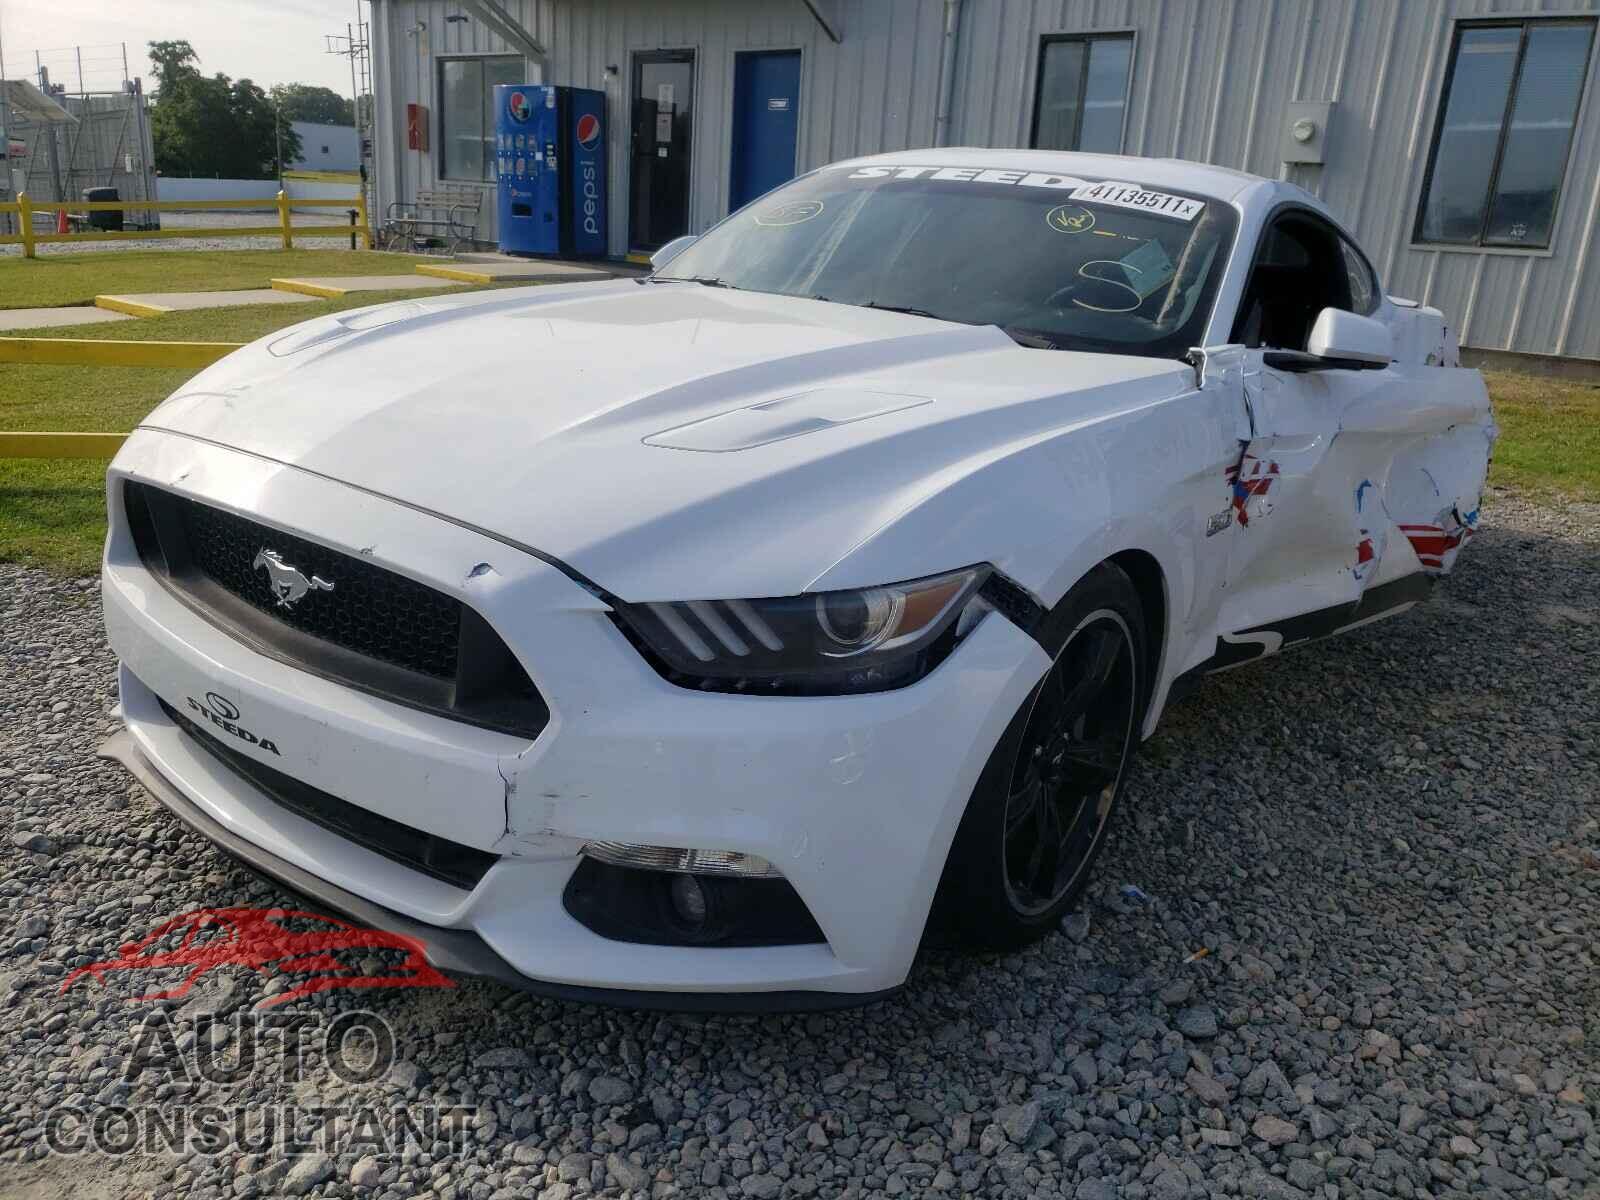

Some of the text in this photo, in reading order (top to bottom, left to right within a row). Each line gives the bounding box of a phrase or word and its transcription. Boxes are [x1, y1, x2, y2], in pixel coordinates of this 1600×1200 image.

[580, 160, 599, 234] pepsi
[848, 166, 1143, 190] STEED
[186, 696, 281, 756] STEEDA
